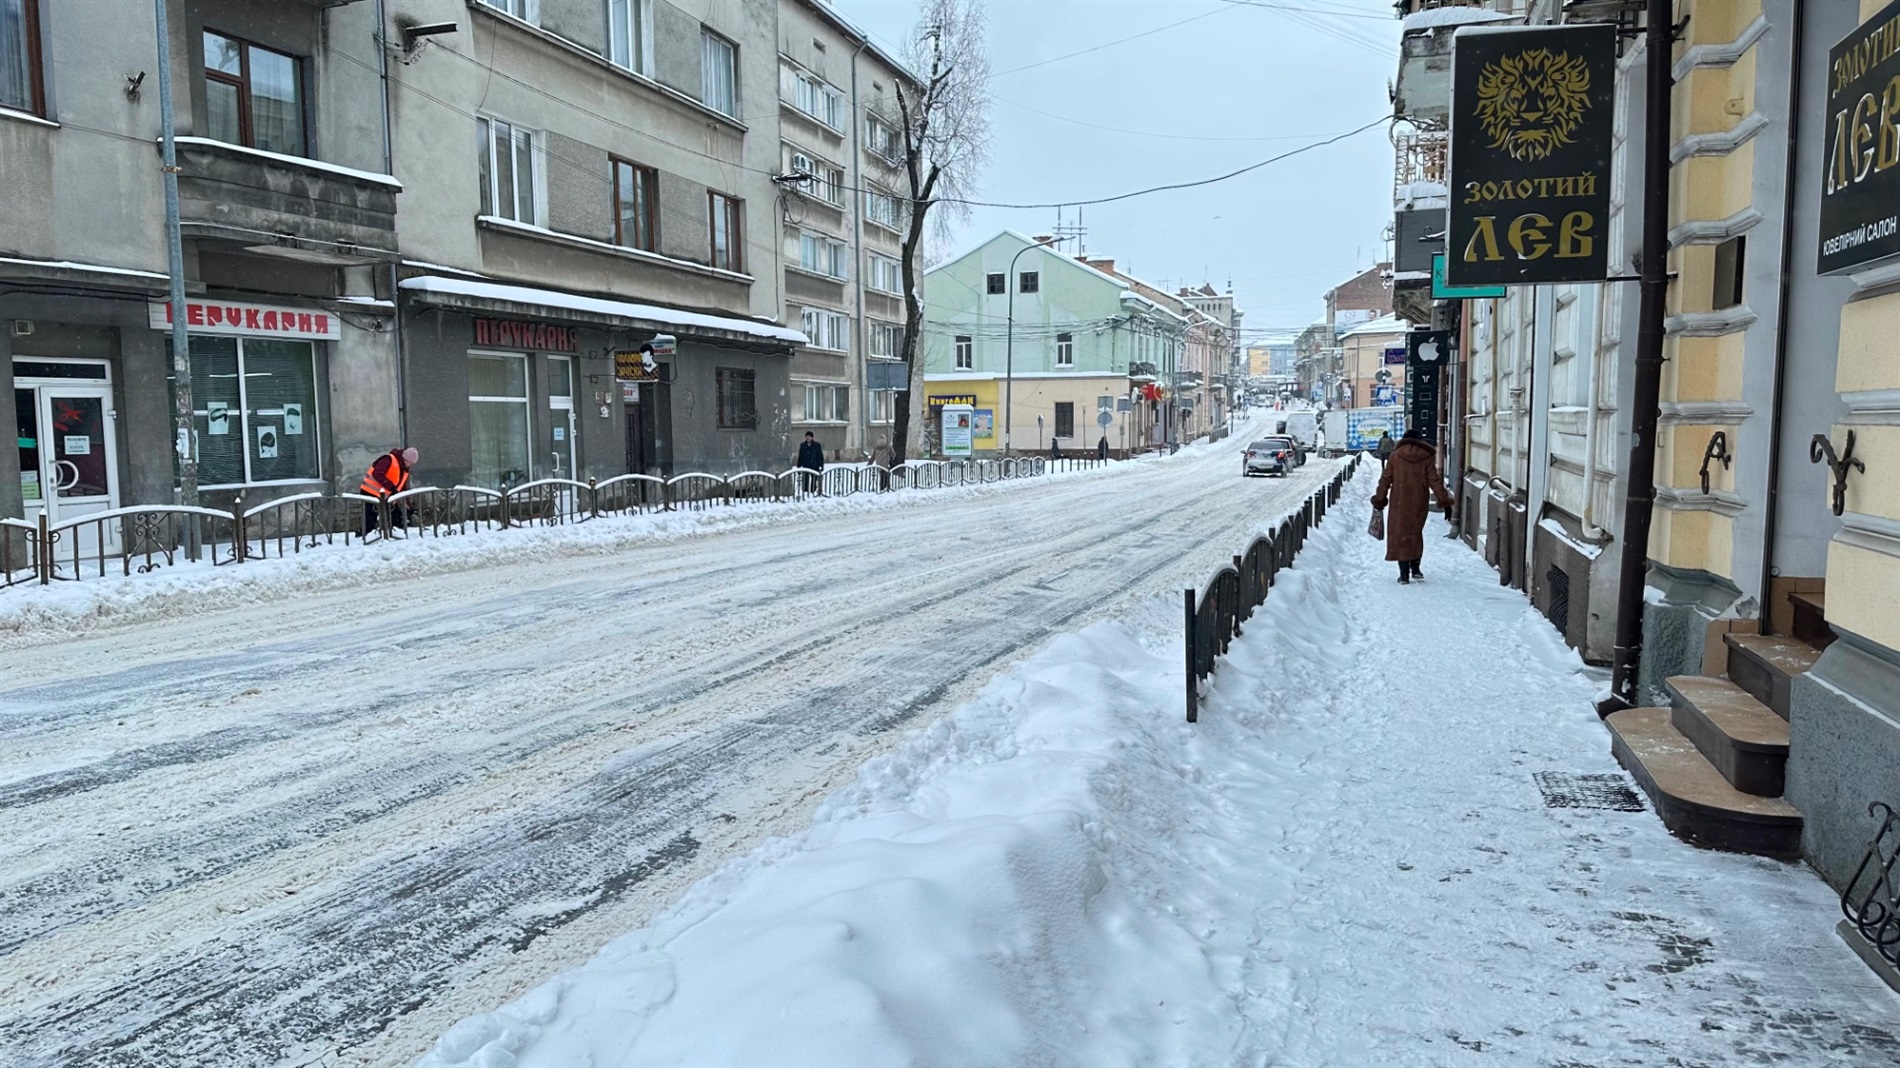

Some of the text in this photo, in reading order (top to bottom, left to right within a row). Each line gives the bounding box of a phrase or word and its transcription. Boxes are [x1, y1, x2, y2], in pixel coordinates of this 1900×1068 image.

[1827, 74, 1900, 196] ЛЄВ
[1463, 171, 1597, 204] ЗОЛОТИЙ
[1463, 210, 1594, 262] ЛЄВ
[1823, 215, 1897, 257] ЮВЕЛІРНИЙ САЛОН
[475, 318, 579, 352] ПЕРУКАРНЯ
